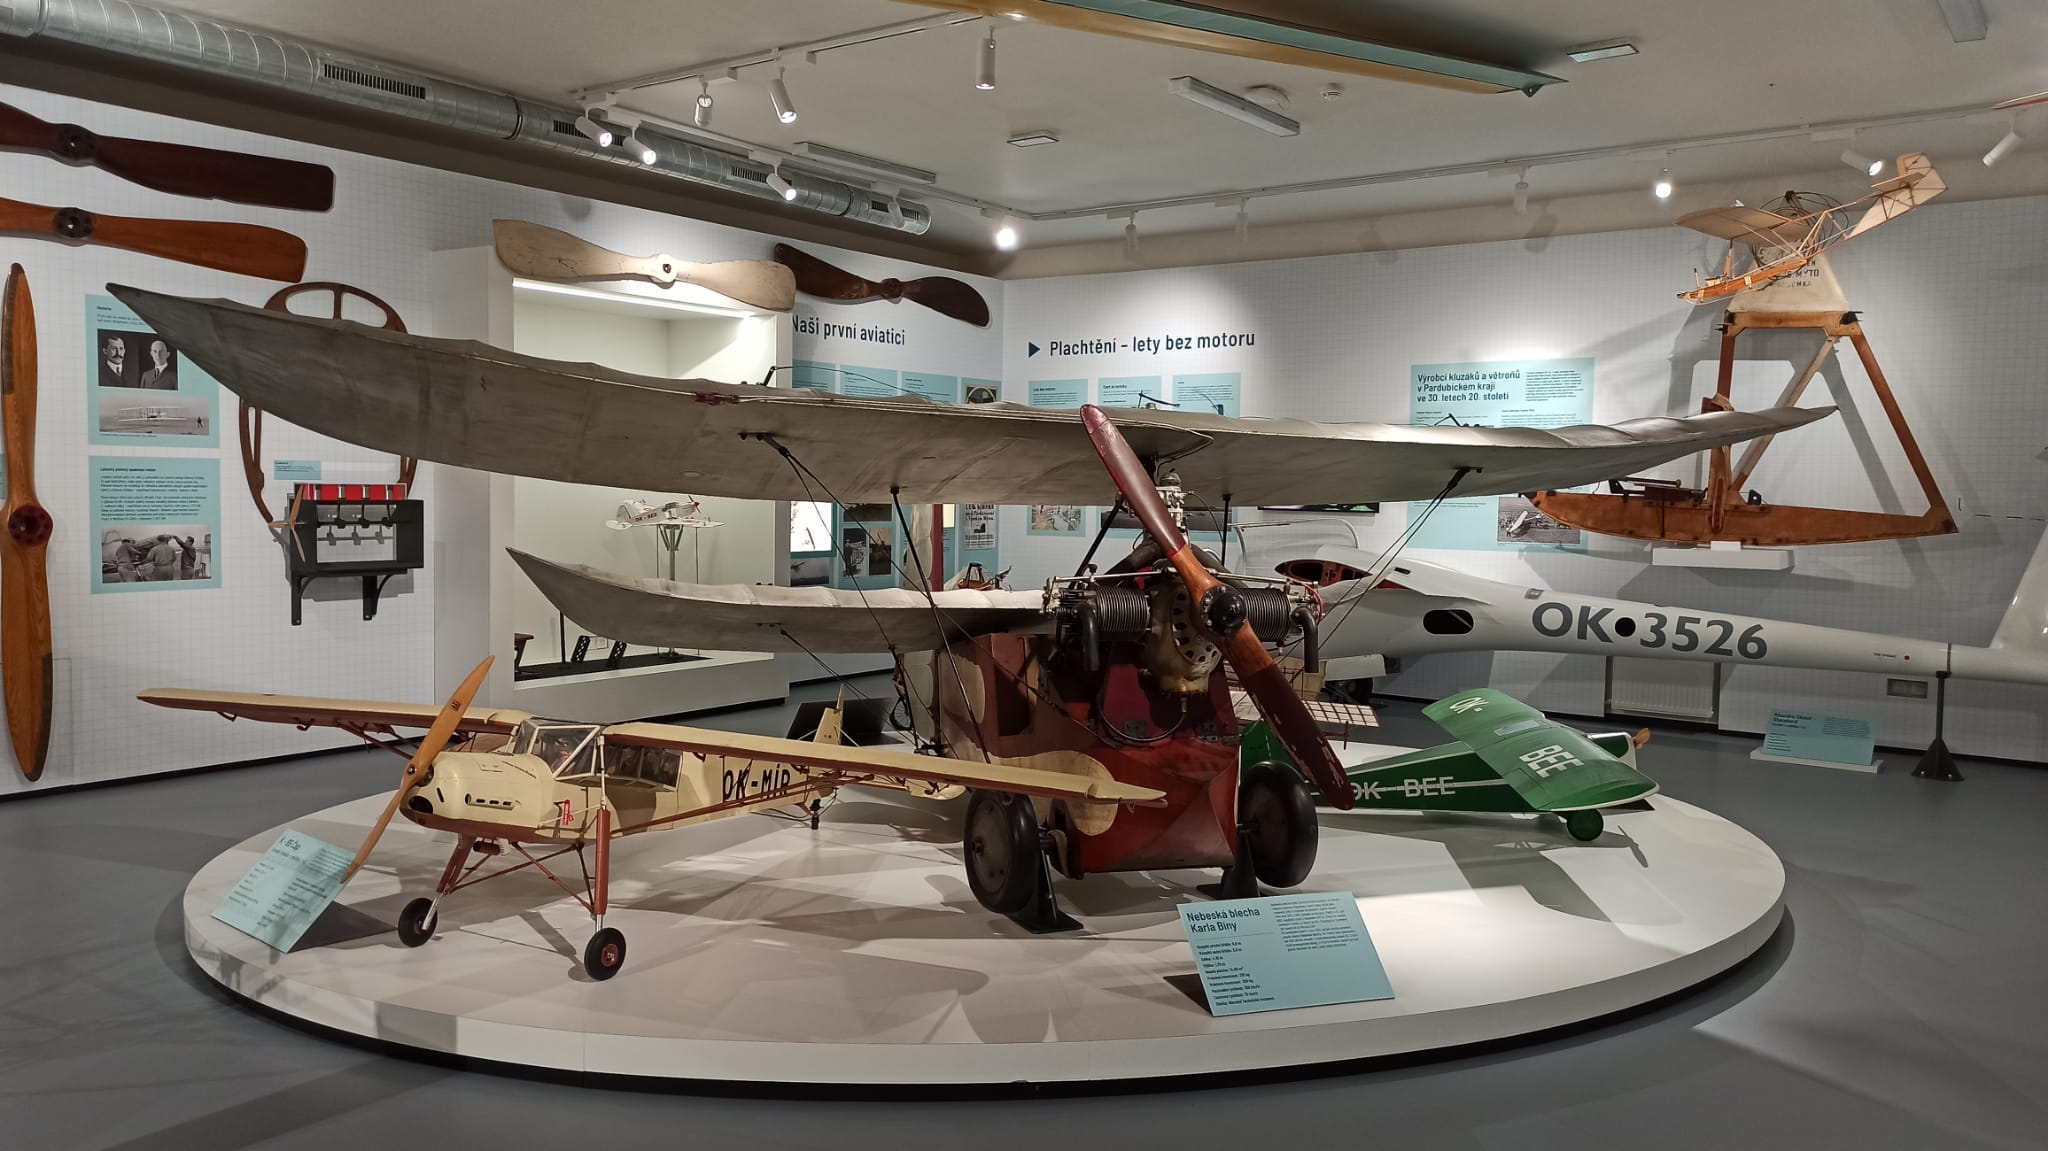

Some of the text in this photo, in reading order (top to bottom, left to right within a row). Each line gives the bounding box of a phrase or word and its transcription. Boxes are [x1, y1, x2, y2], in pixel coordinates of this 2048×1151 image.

[793, 315, 905, 345] Naši první aviatici
[1049, 338, 1117, 357] Plachtění
[1133, 336, 1161, 355] lety
[1166, 334, 1192, 350] bez
[1197, 332, 1256, 349] motoru
[1477, 382, 1496, 392] kraji
[1441, 393, 1467, 402] letech
[1518, 744, 1585, 779] BEE
[1403, 776, 1456, 798] BEE
[1186, 907, 1261, 922] Nebeská blecha
[1190, 923, 1217, 934] Karla
